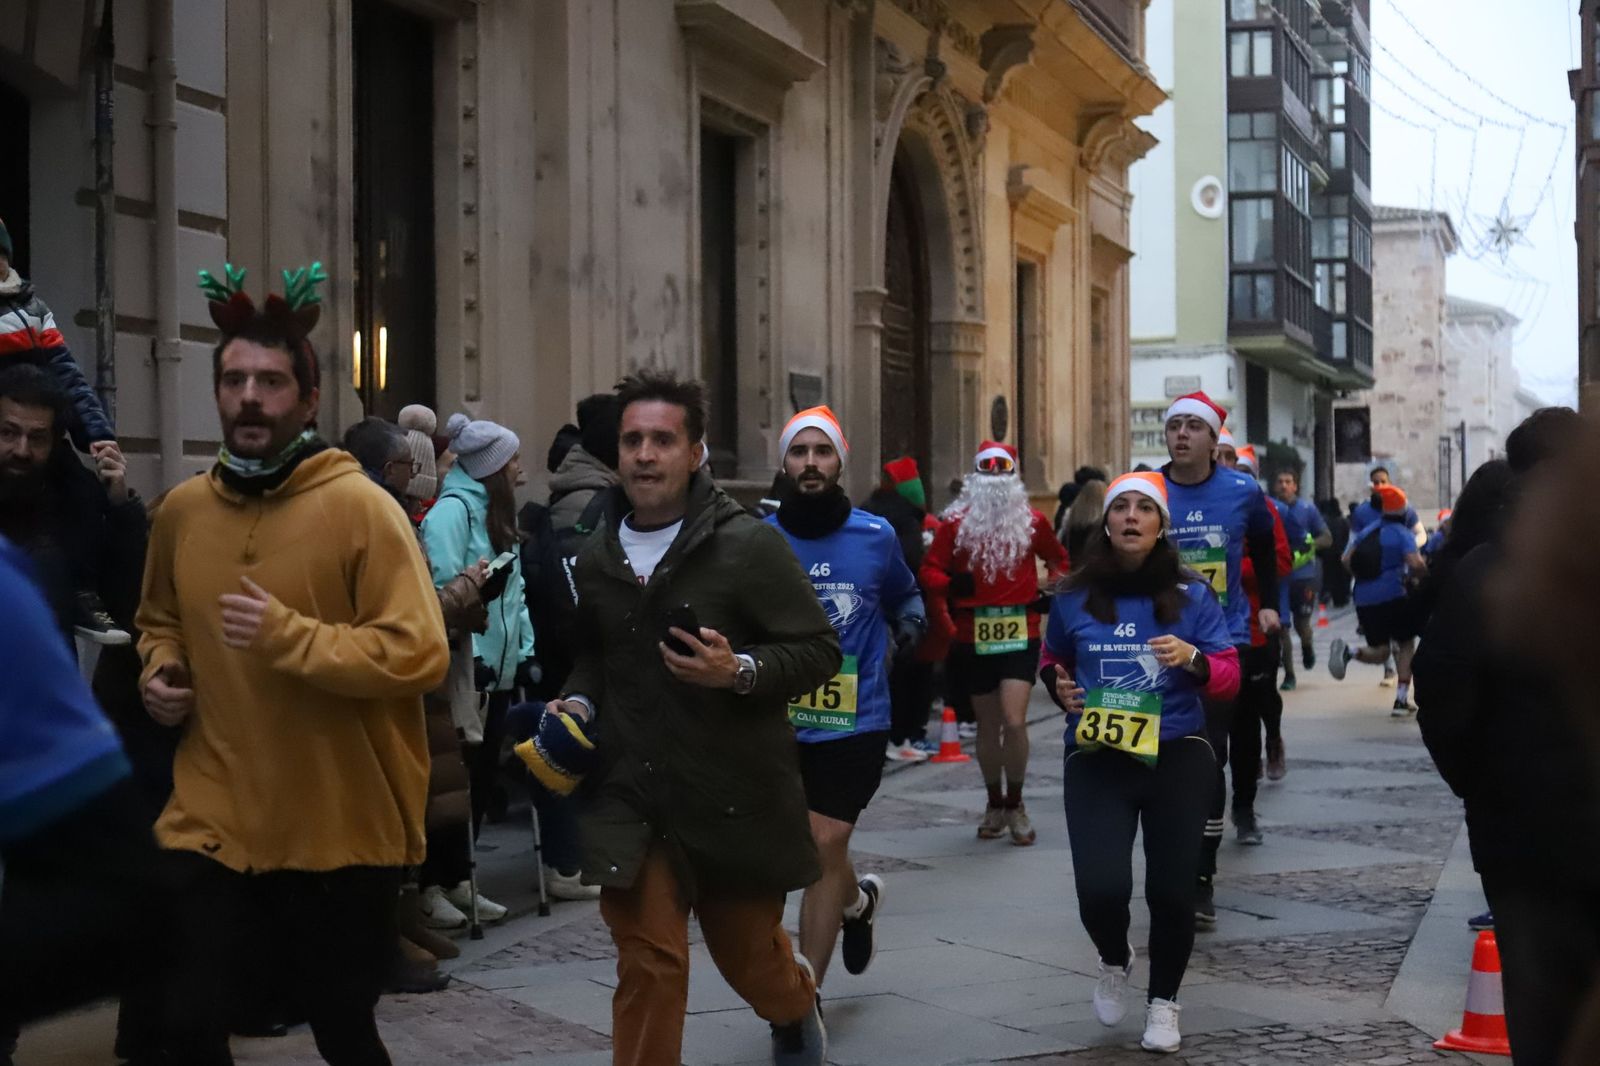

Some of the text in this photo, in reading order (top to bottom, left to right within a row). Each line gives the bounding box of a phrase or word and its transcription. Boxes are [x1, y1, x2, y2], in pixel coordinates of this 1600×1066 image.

[1186, 511, 1203, 522] 46
[809, 562, 831, 577] 46
[978, 622, 1019, 641] 882
[1113, 623, 1136, 637] 46
[797, 712, 851, 726] CAJA RURAL
[1081, 711, 1149, 747] 357
